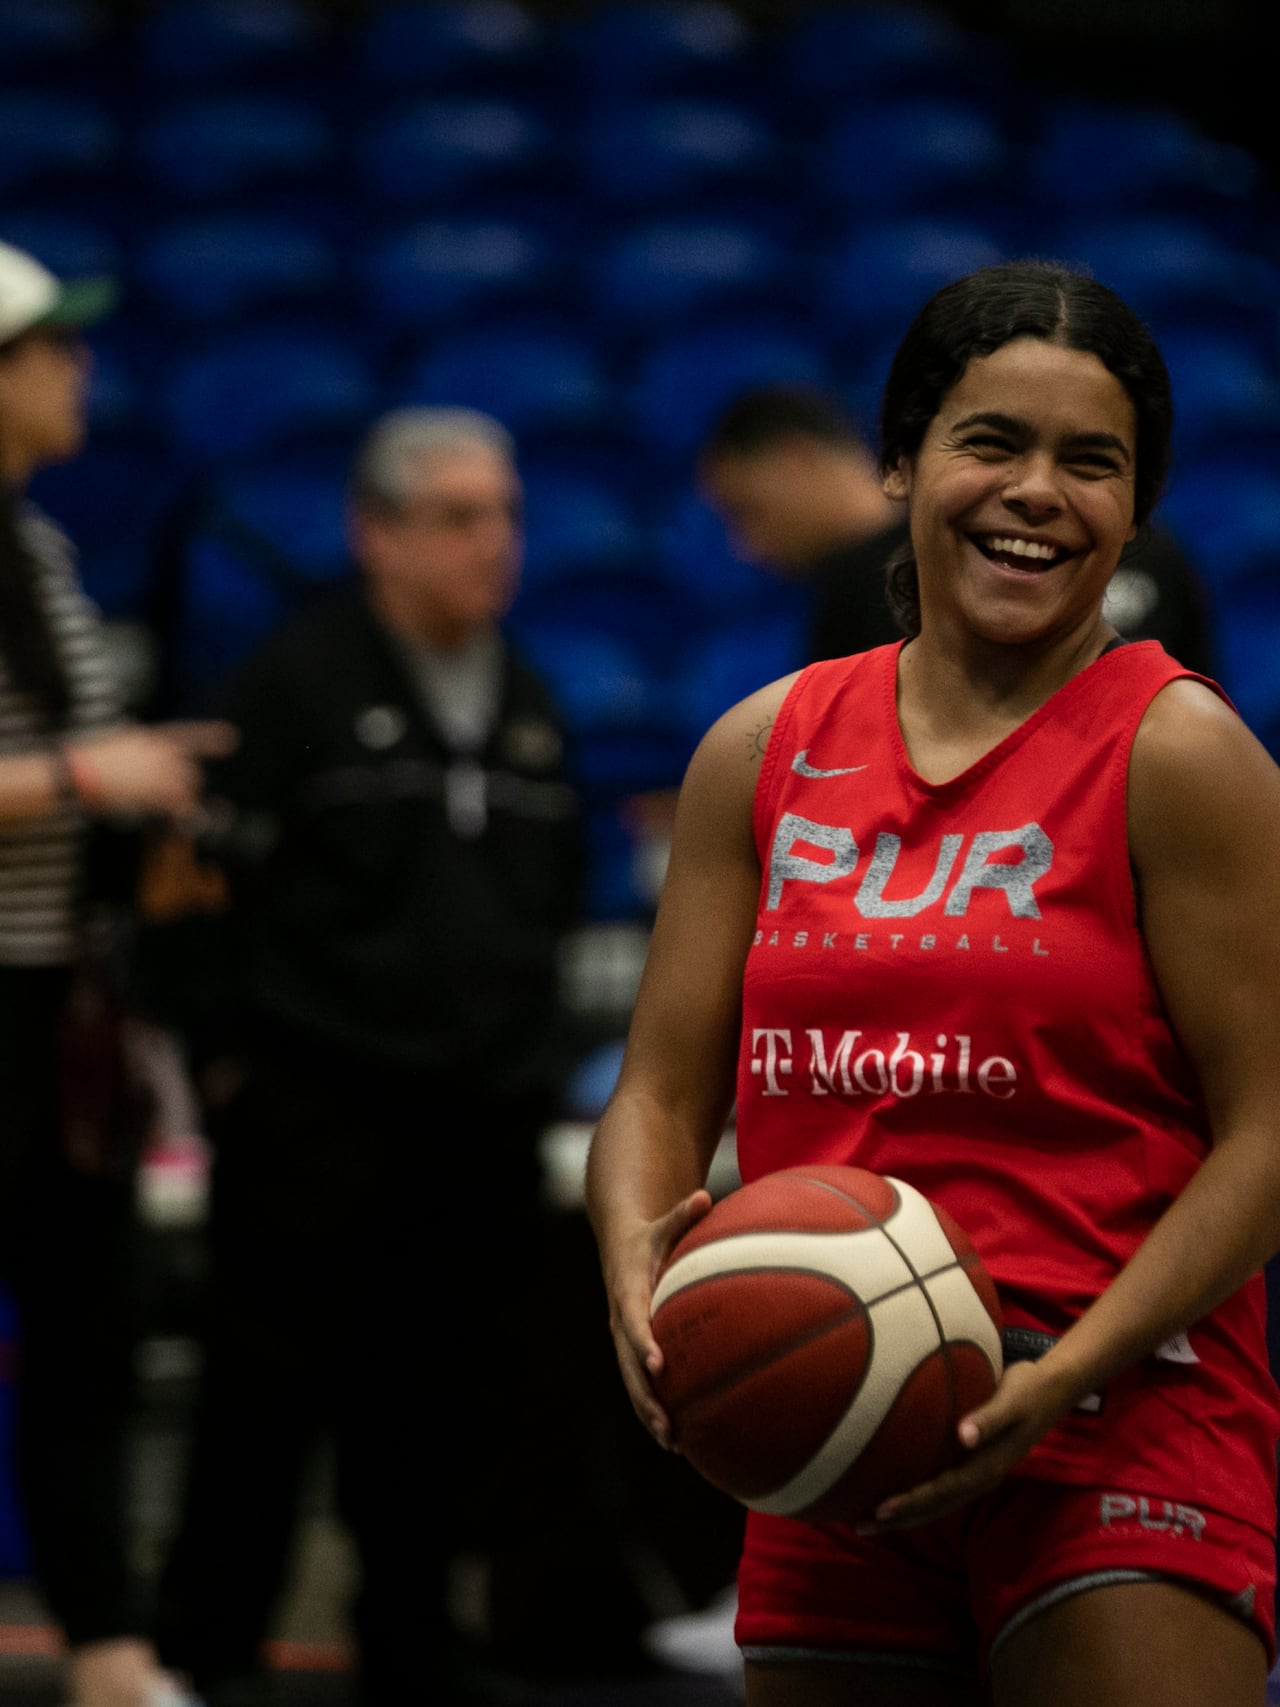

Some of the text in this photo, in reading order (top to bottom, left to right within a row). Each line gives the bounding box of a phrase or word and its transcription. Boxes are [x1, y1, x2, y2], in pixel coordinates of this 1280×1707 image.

[767, 811, 1053, 919] PUR
[753, 930, 1050, 955] BASKETBALL
[806, 1029, 1018, 1099] Mobile
[1101, 1494, 1206, 1540] PUR
